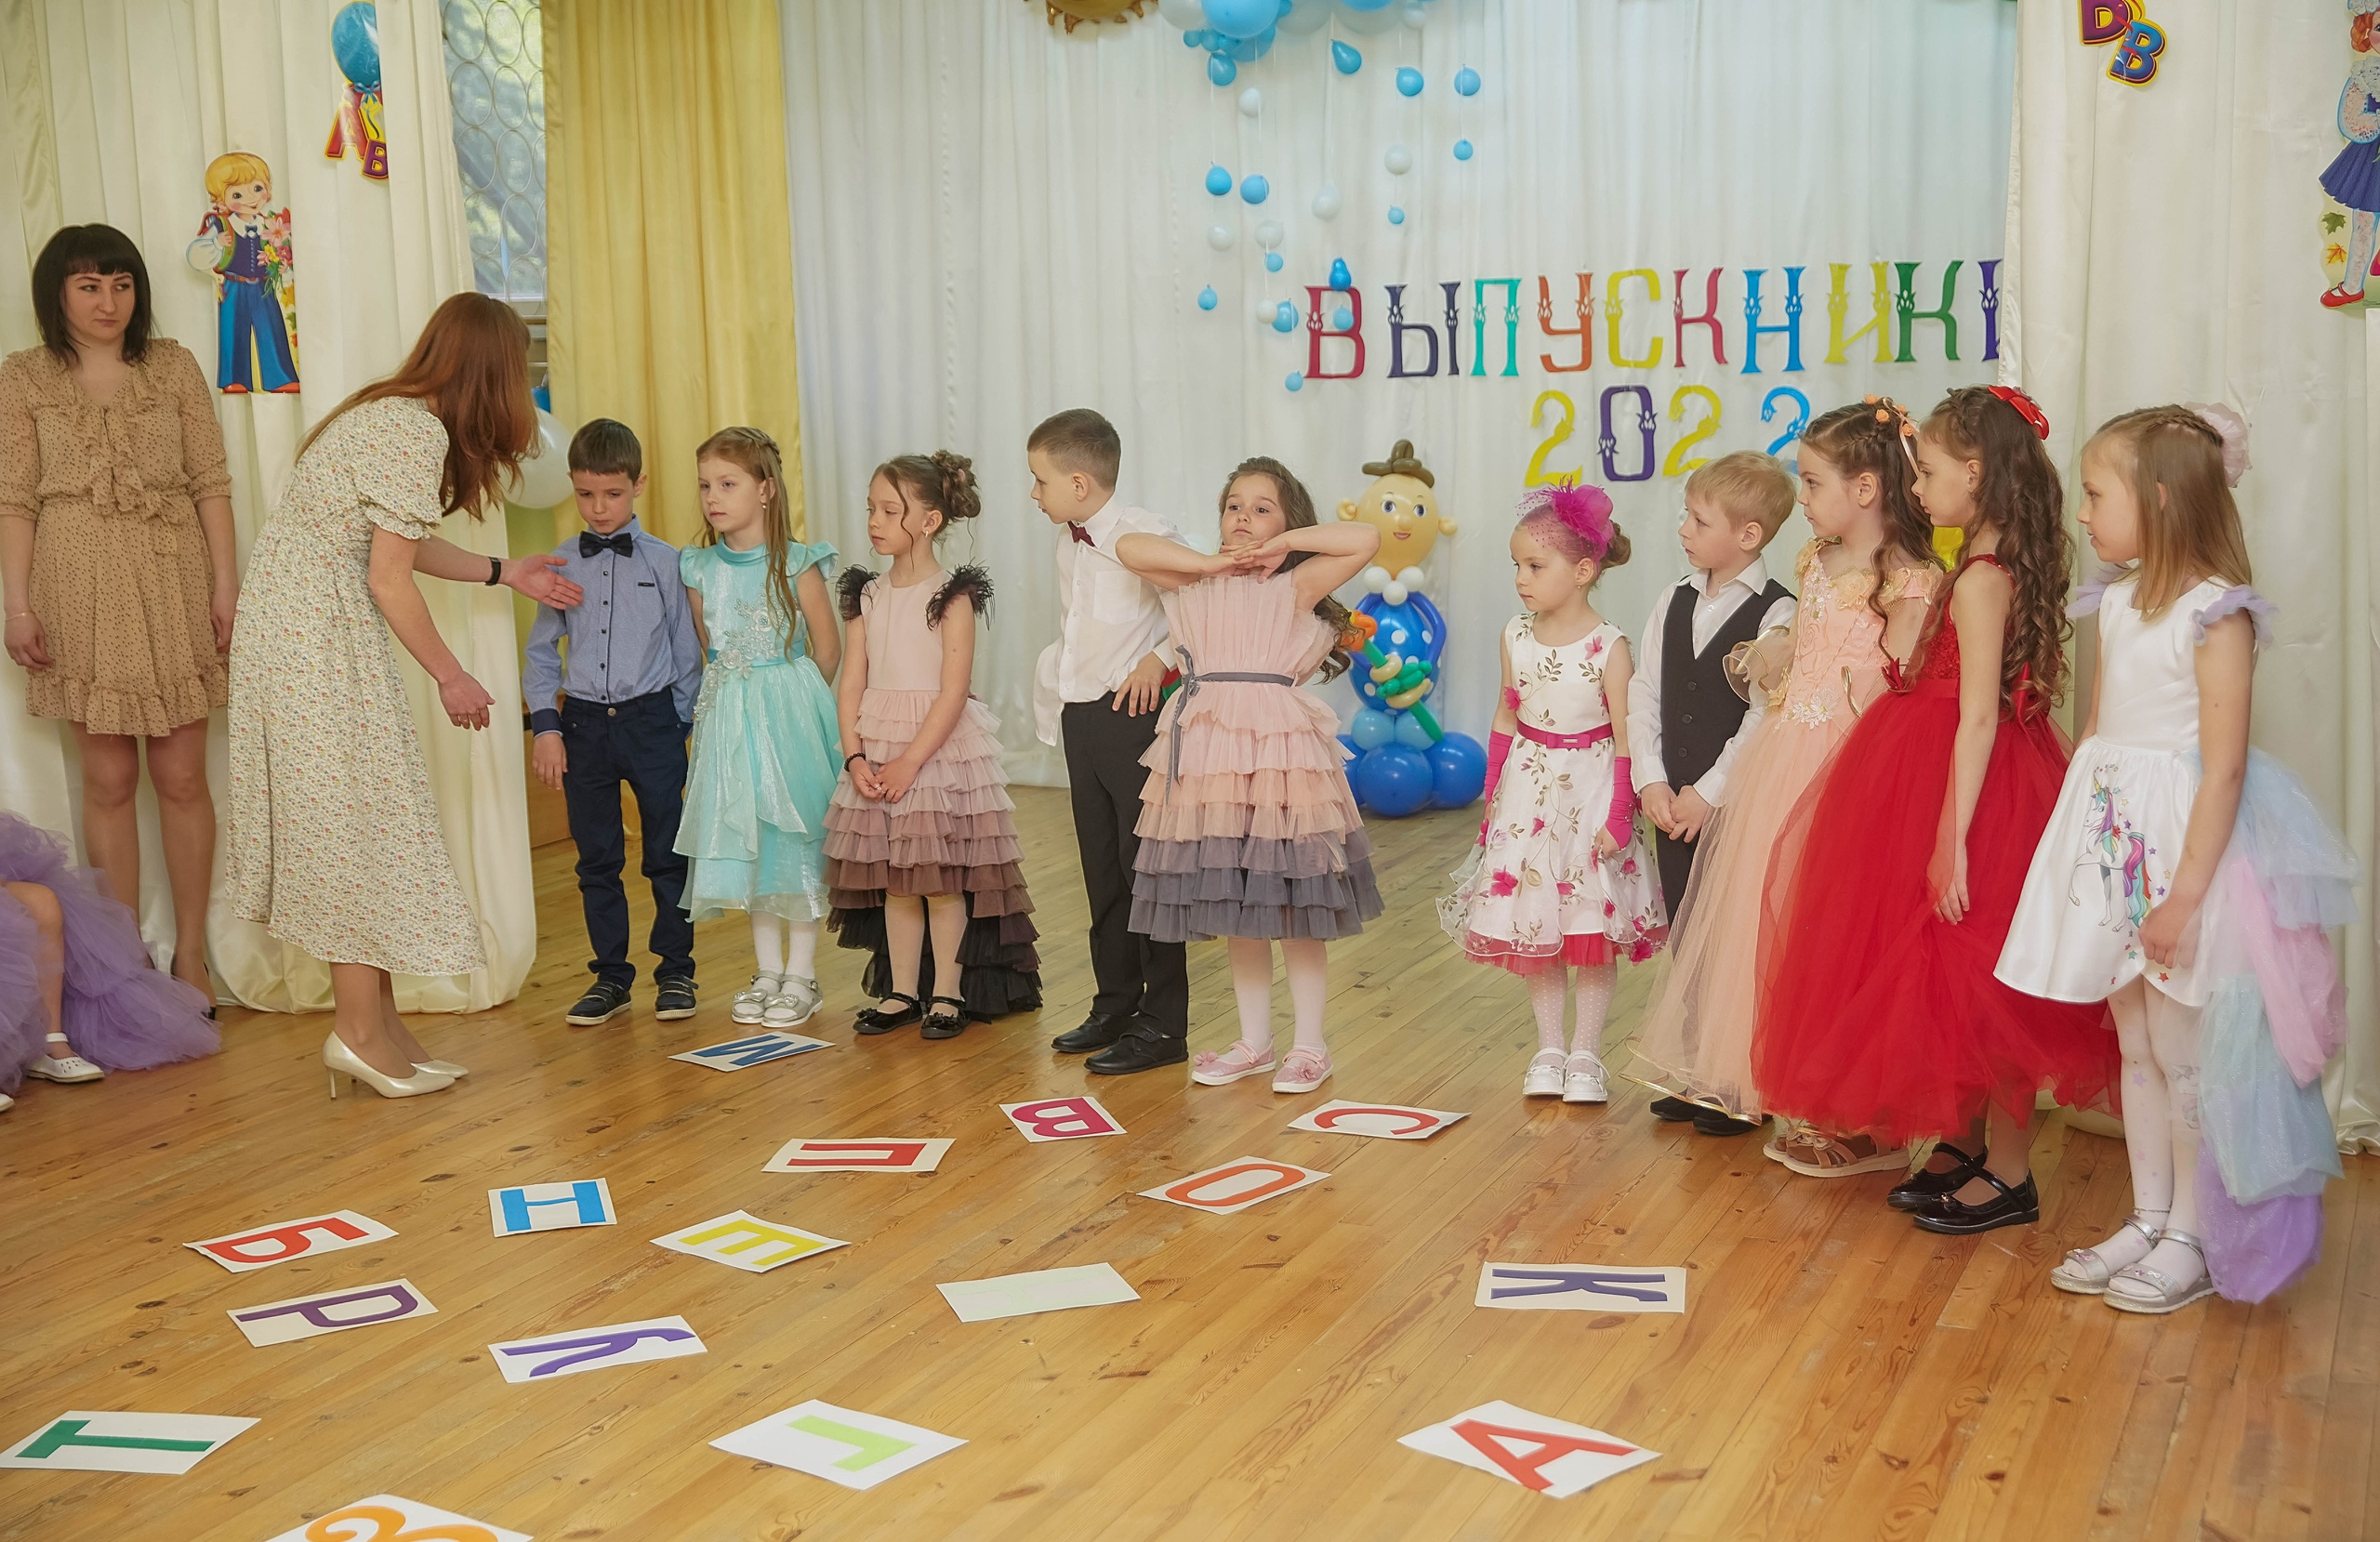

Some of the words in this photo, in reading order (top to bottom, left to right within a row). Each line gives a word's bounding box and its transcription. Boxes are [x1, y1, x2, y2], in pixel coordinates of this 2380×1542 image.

[1011, 1097, 1117, 1139] В
[1314, 1107, 1440, 1136] С
[786, 1142, 929, 1167] П
[499, 1180, 607, 1232] Н
[1164, 1163, 1307, 1207] О
[199, 1217, 370, 1264] Б
[677, 1218, 829, 1266] Е
[235, 1285, 418, 1327] Р
[1491, 1268, 1668, 1302] К
[15, 1419, 217, 1459] Т
[786, 1414, 917, 1472] Г
[1448, 1418, 1642, 1493] А
